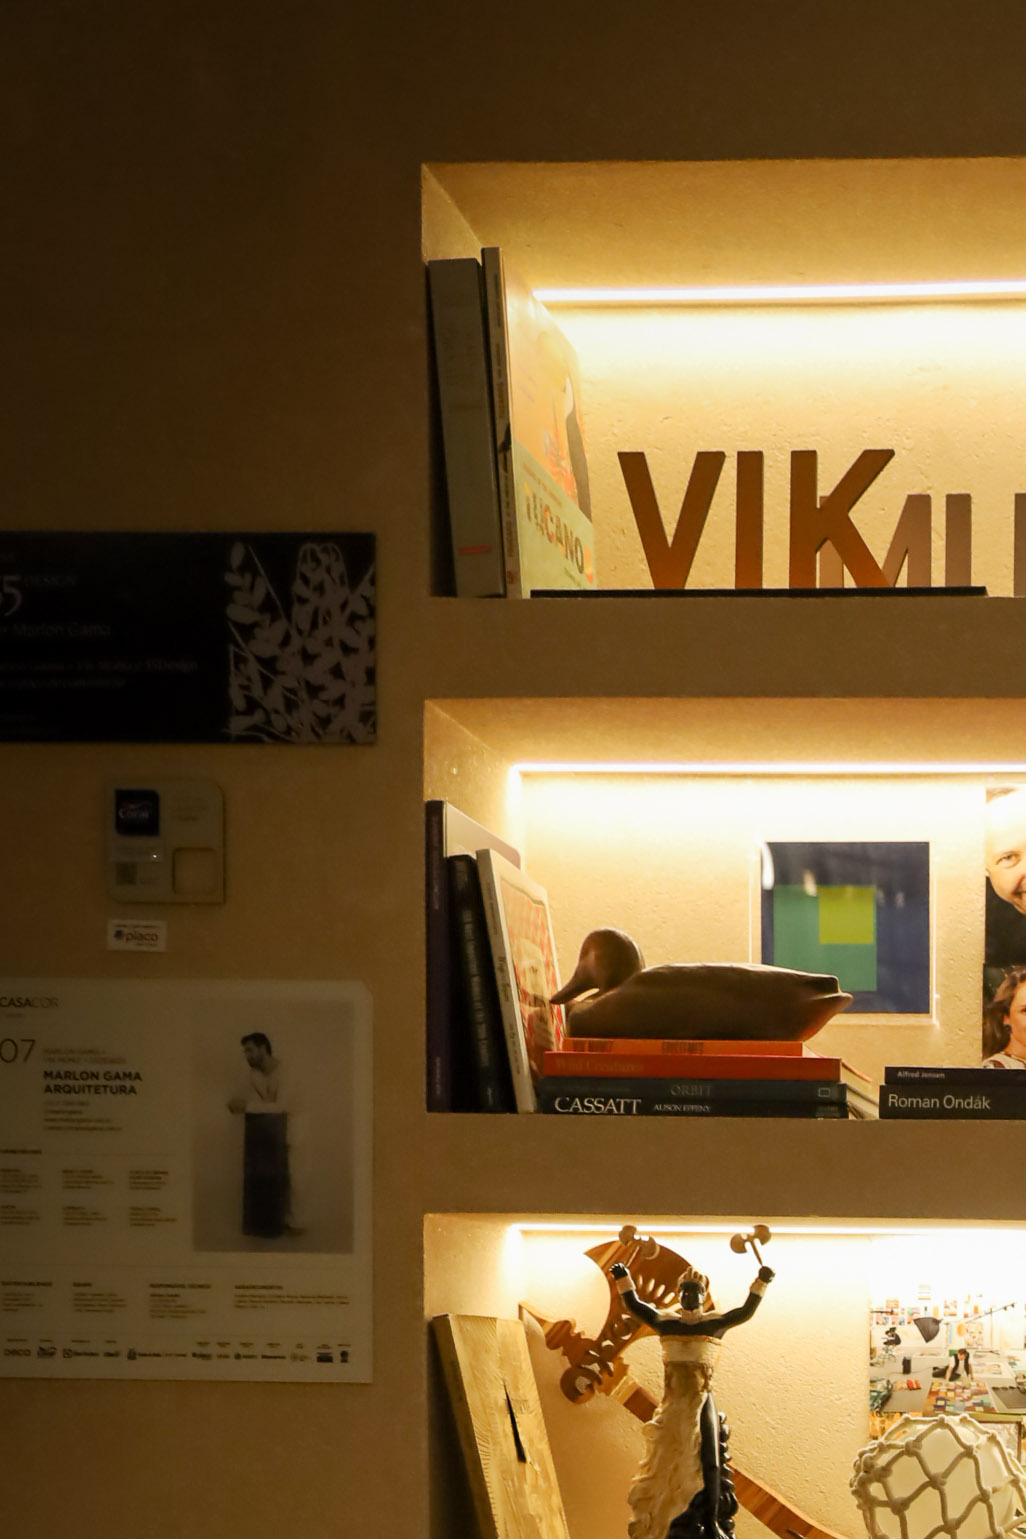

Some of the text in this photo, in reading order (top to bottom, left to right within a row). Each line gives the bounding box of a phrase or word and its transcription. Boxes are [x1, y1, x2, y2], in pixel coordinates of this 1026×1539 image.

[617, 449, 896, 589] VIK
[0, 573, 22, 617] 5
[0, 1038, 36, 1063] 07
[43, 1070, 142, 1082] MARLON GAMA
[897, 1070, 919, 1078] Alfred
[44, 1084, 137, 1095] ARQUITETURA
[670, 1085, 714, 1097] ORBIT
[554, 1096, 642, 1114] CASSATT
[888, 1093, 991, 1110] Roman Ondák
